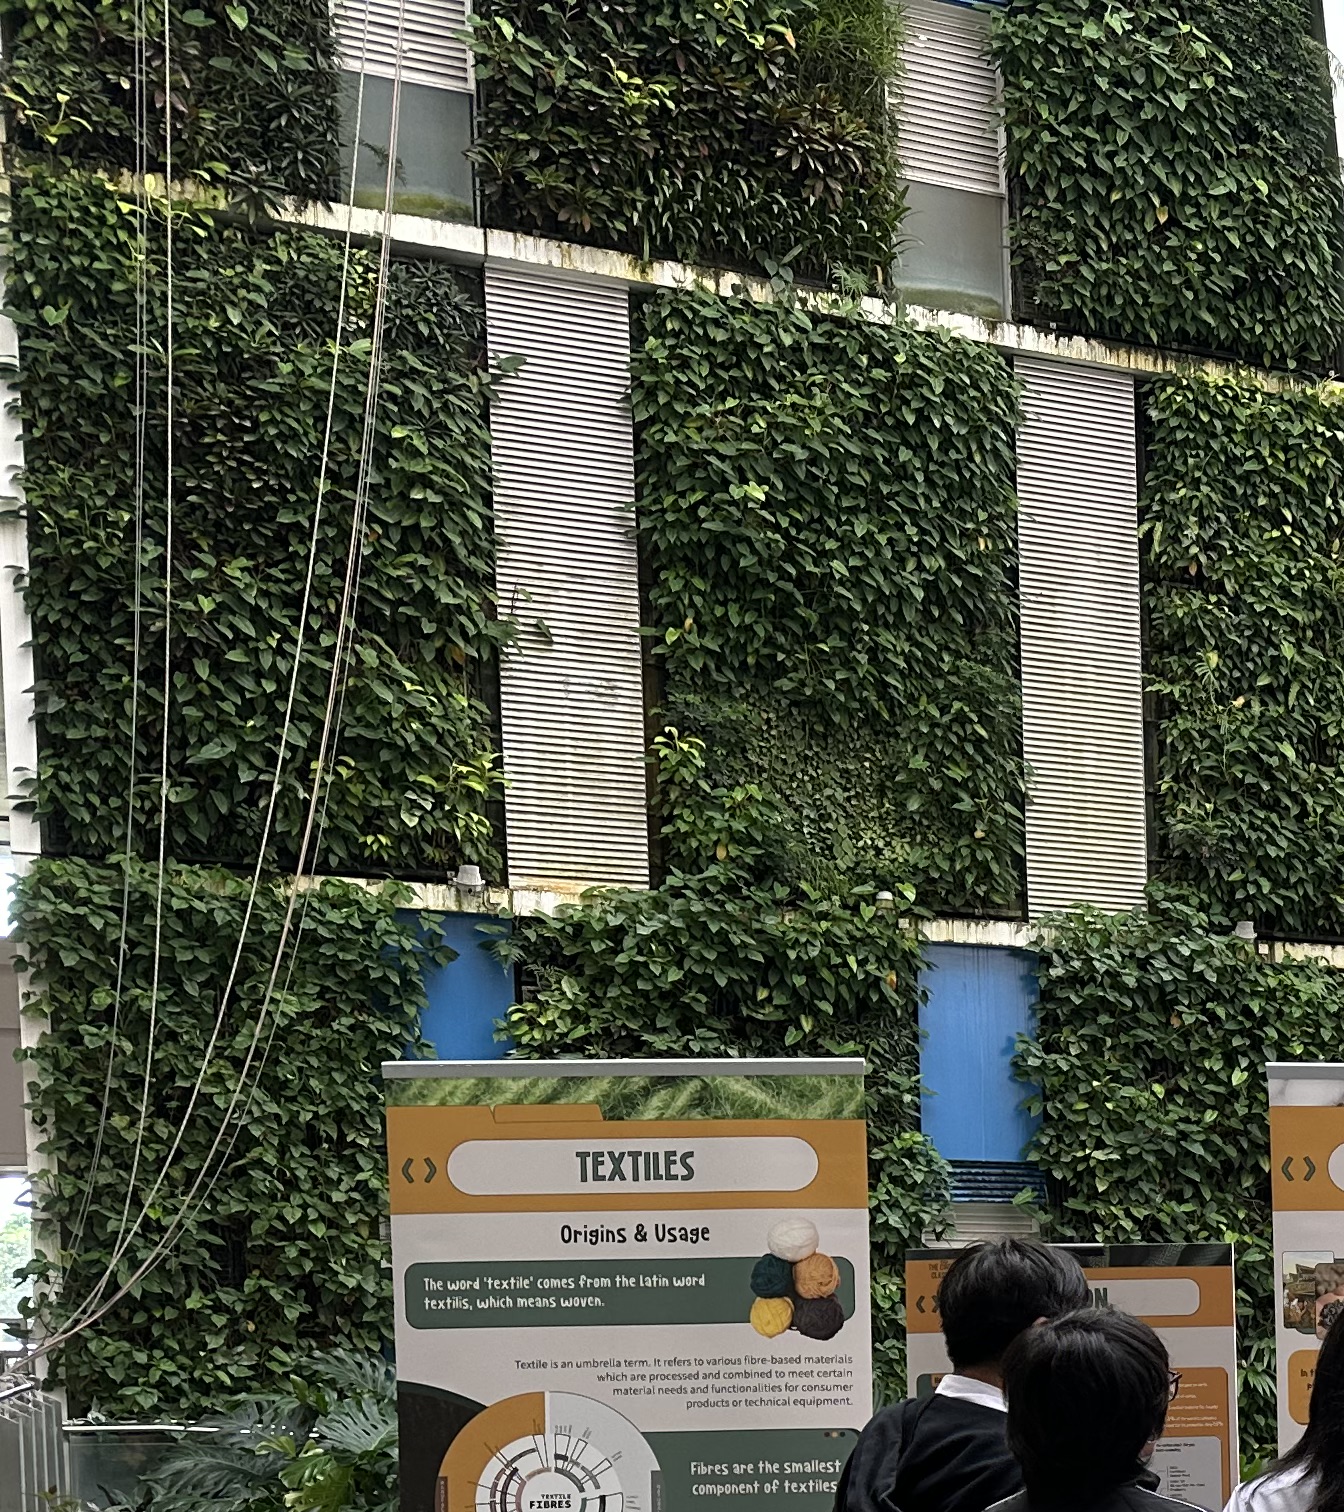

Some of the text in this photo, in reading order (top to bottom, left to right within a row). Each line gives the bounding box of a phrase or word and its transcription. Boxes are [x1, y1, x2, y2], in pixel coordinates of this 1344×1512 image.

[576, 1150, 694, 1182] TEXTILES
[561, 1224, 709, 1245] Origins & Usage
[424, 1278, 443, 1290] The
[448, 1277, 479, 1290] word
[537, 1278, 574, 1288] comes
[579, 1275, 611, 1288] from
[615, 1275, 635, 1287] the
[673, 1274, 704, 1286] word
[424, 1296, 604, 1310] textilis, which means woven.
[691, 1460, 841, 1475] Fibres are the smallest
[692, 1479, 838, 1497] component of textiles
